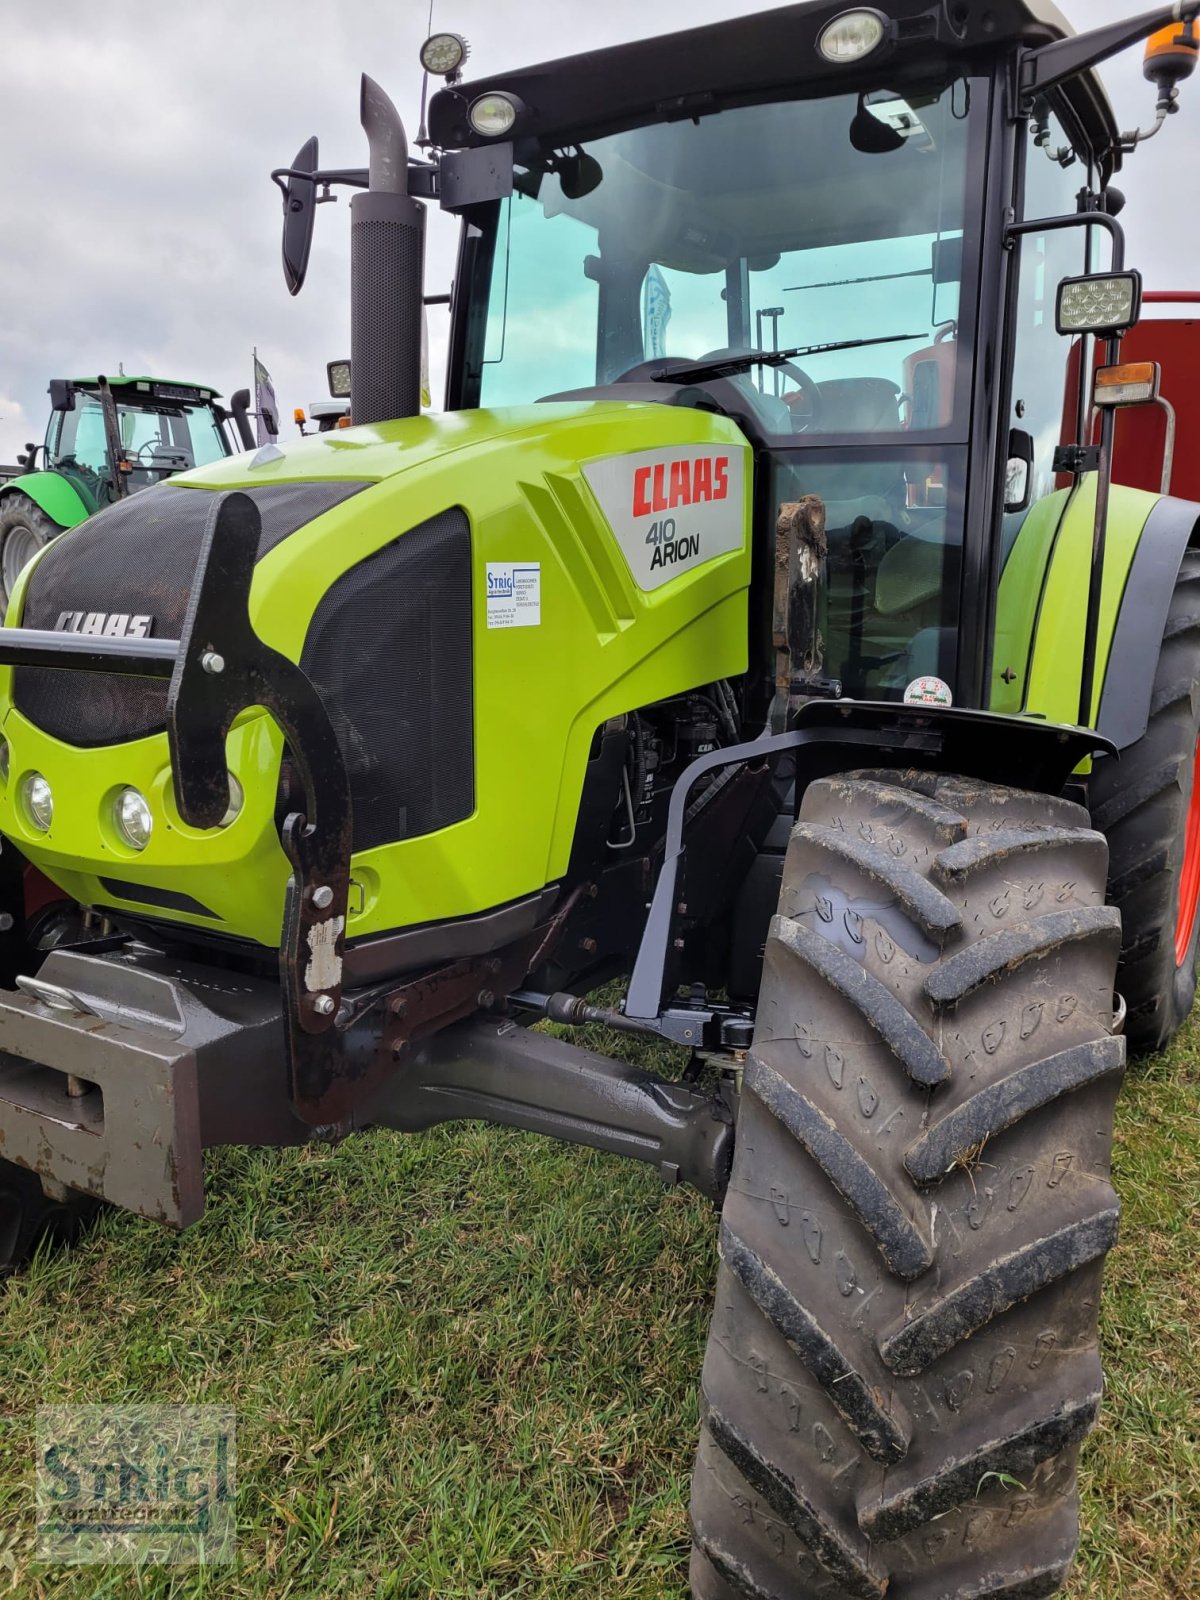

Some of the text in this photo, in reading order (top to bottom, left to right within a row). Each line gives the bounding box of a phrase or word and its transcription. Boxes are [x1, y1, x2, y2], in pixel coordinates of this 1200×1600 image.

[633, 457, 728, 517] CLAAS
[645, 518, 676, 545] 410
[650, 533, 700, 570] ARION
[54, 611, 152, 638] CLAAS
